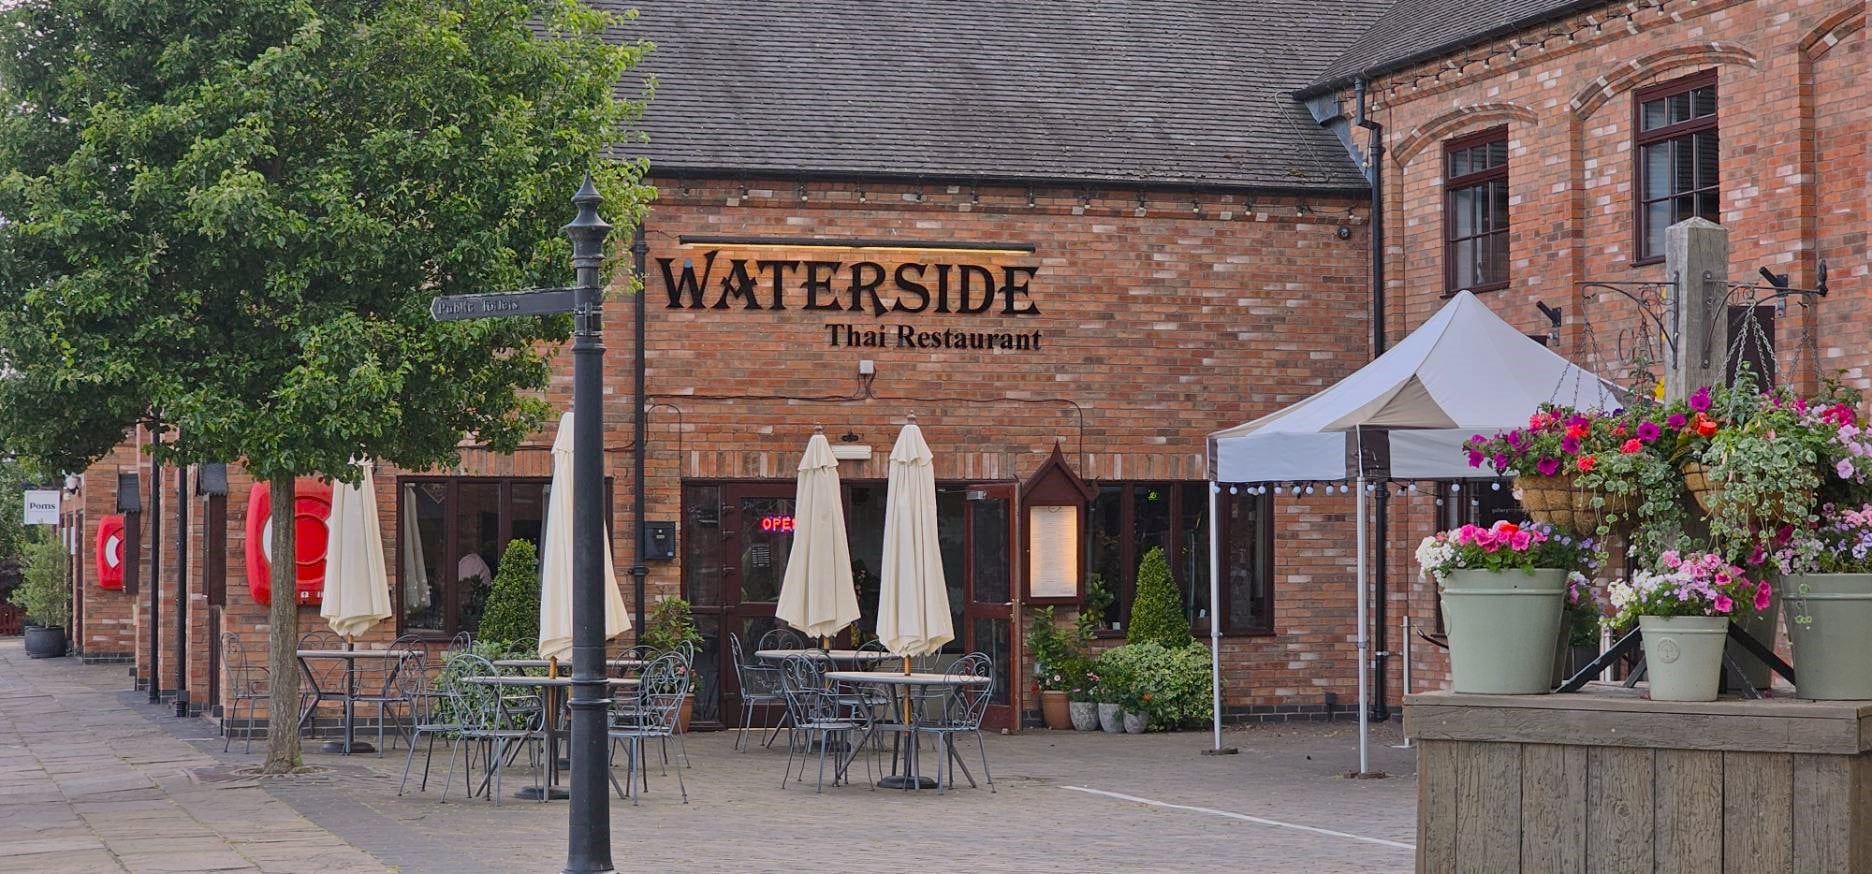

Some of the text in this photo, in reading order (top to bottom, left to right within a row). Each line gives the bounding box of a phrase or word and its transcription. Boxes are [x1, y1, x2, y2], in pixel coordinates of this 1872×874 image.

[655, 249, 1042, 318] WATERSIDE
[438, 302, 474, 314] Public
[825, 323, 1042, 351] Thai Restaurant
[30, 502, 56, 510] Poms
